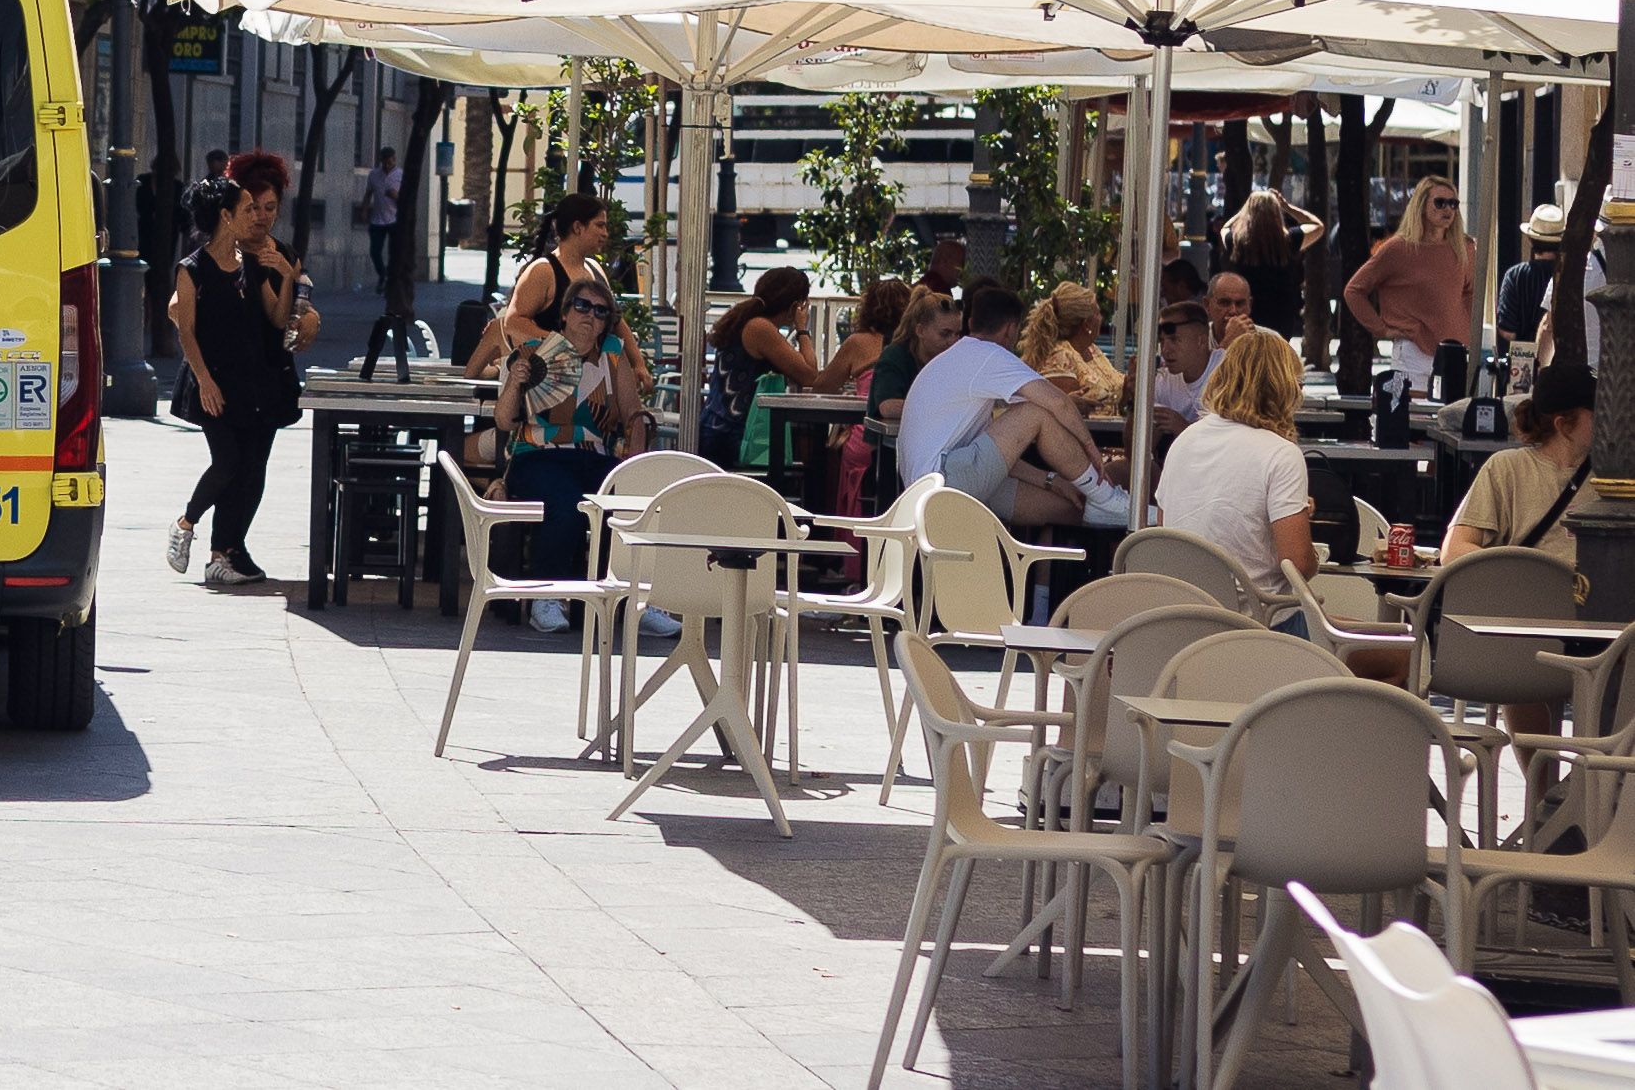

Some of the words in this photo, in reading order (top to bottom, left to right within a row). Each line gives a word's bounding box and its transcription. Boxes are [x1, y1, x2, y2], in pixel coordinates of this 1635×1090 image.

[175, 26, 217, 41] MPRO
[173, 42, 203, 58] ORO
[19, 375, 47, 403] ER
